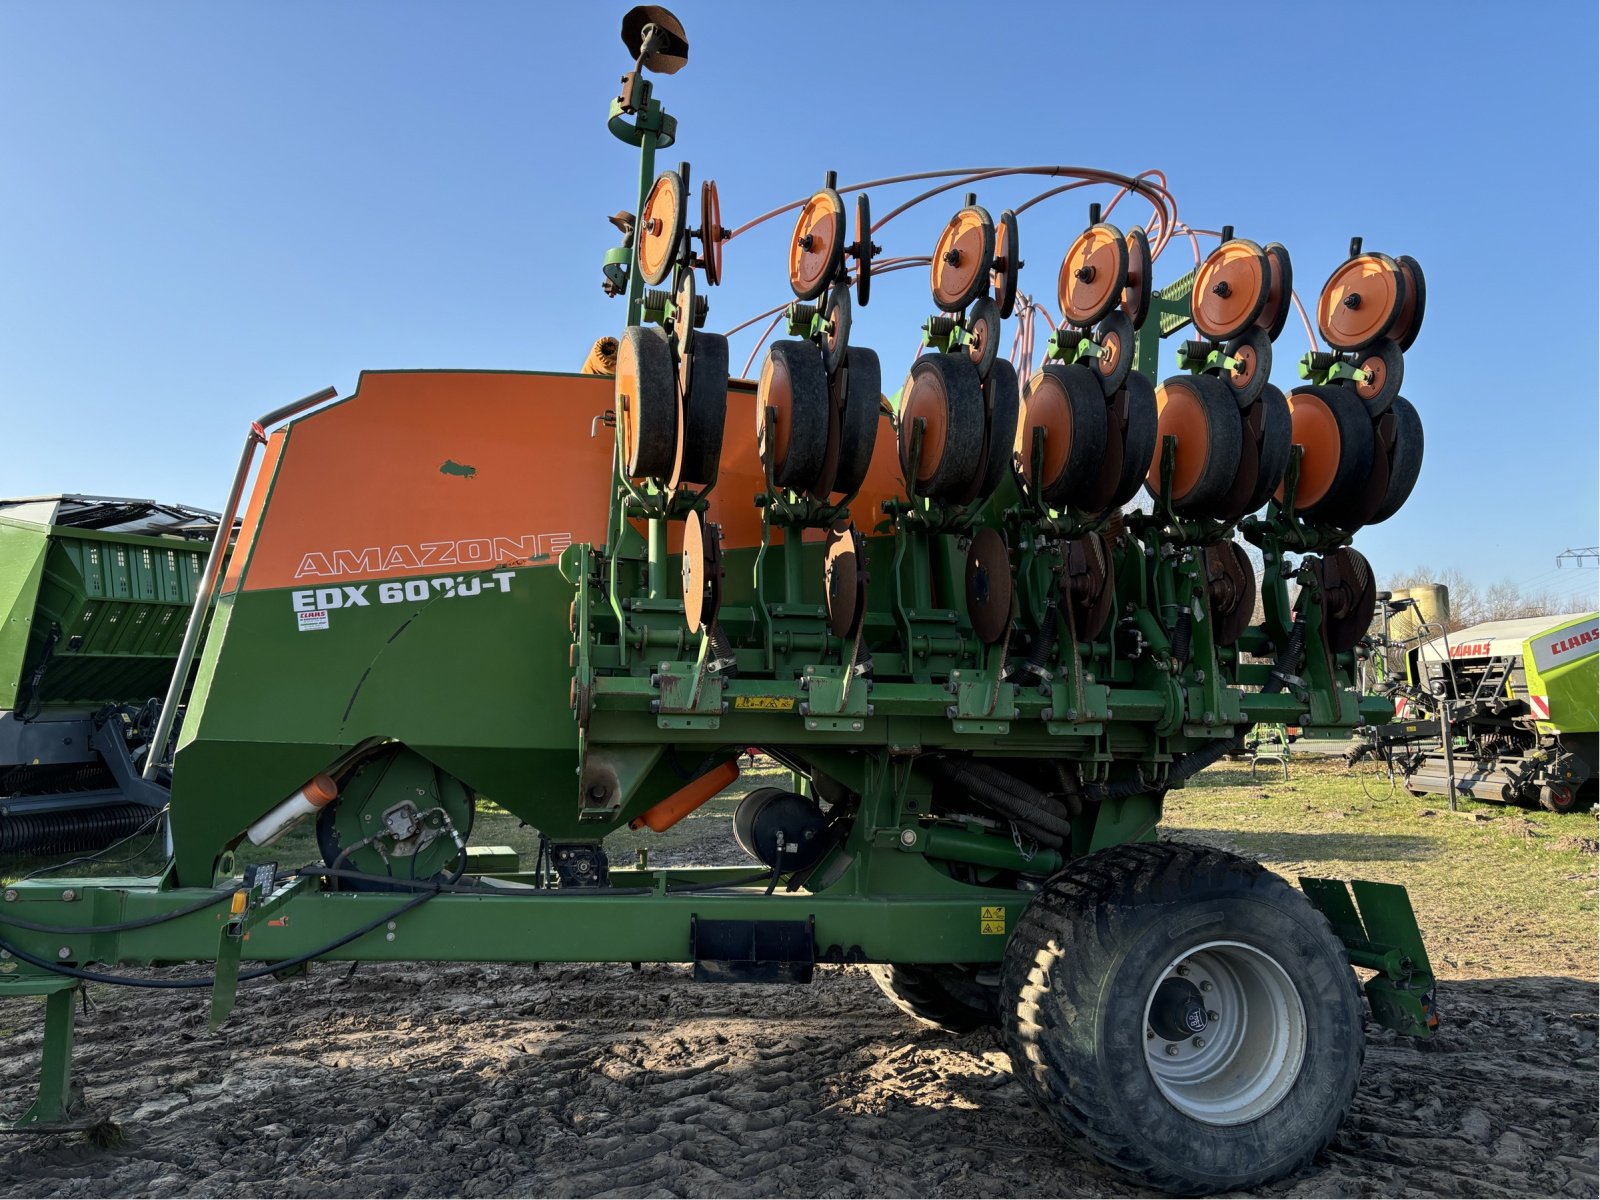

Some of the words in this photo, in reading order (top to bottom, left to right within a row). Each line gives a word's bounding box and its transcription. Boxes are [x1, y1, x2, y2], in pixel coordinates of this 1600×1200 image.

[294, 532, 572, 579] AMAZONE
[292, 585, 371, 612] EDX
[300, 611, 326, 619] CLAAS
[1449, 643, 1491, 657] CLAAS
[1551, 628, 1599, 655] CLAAS
